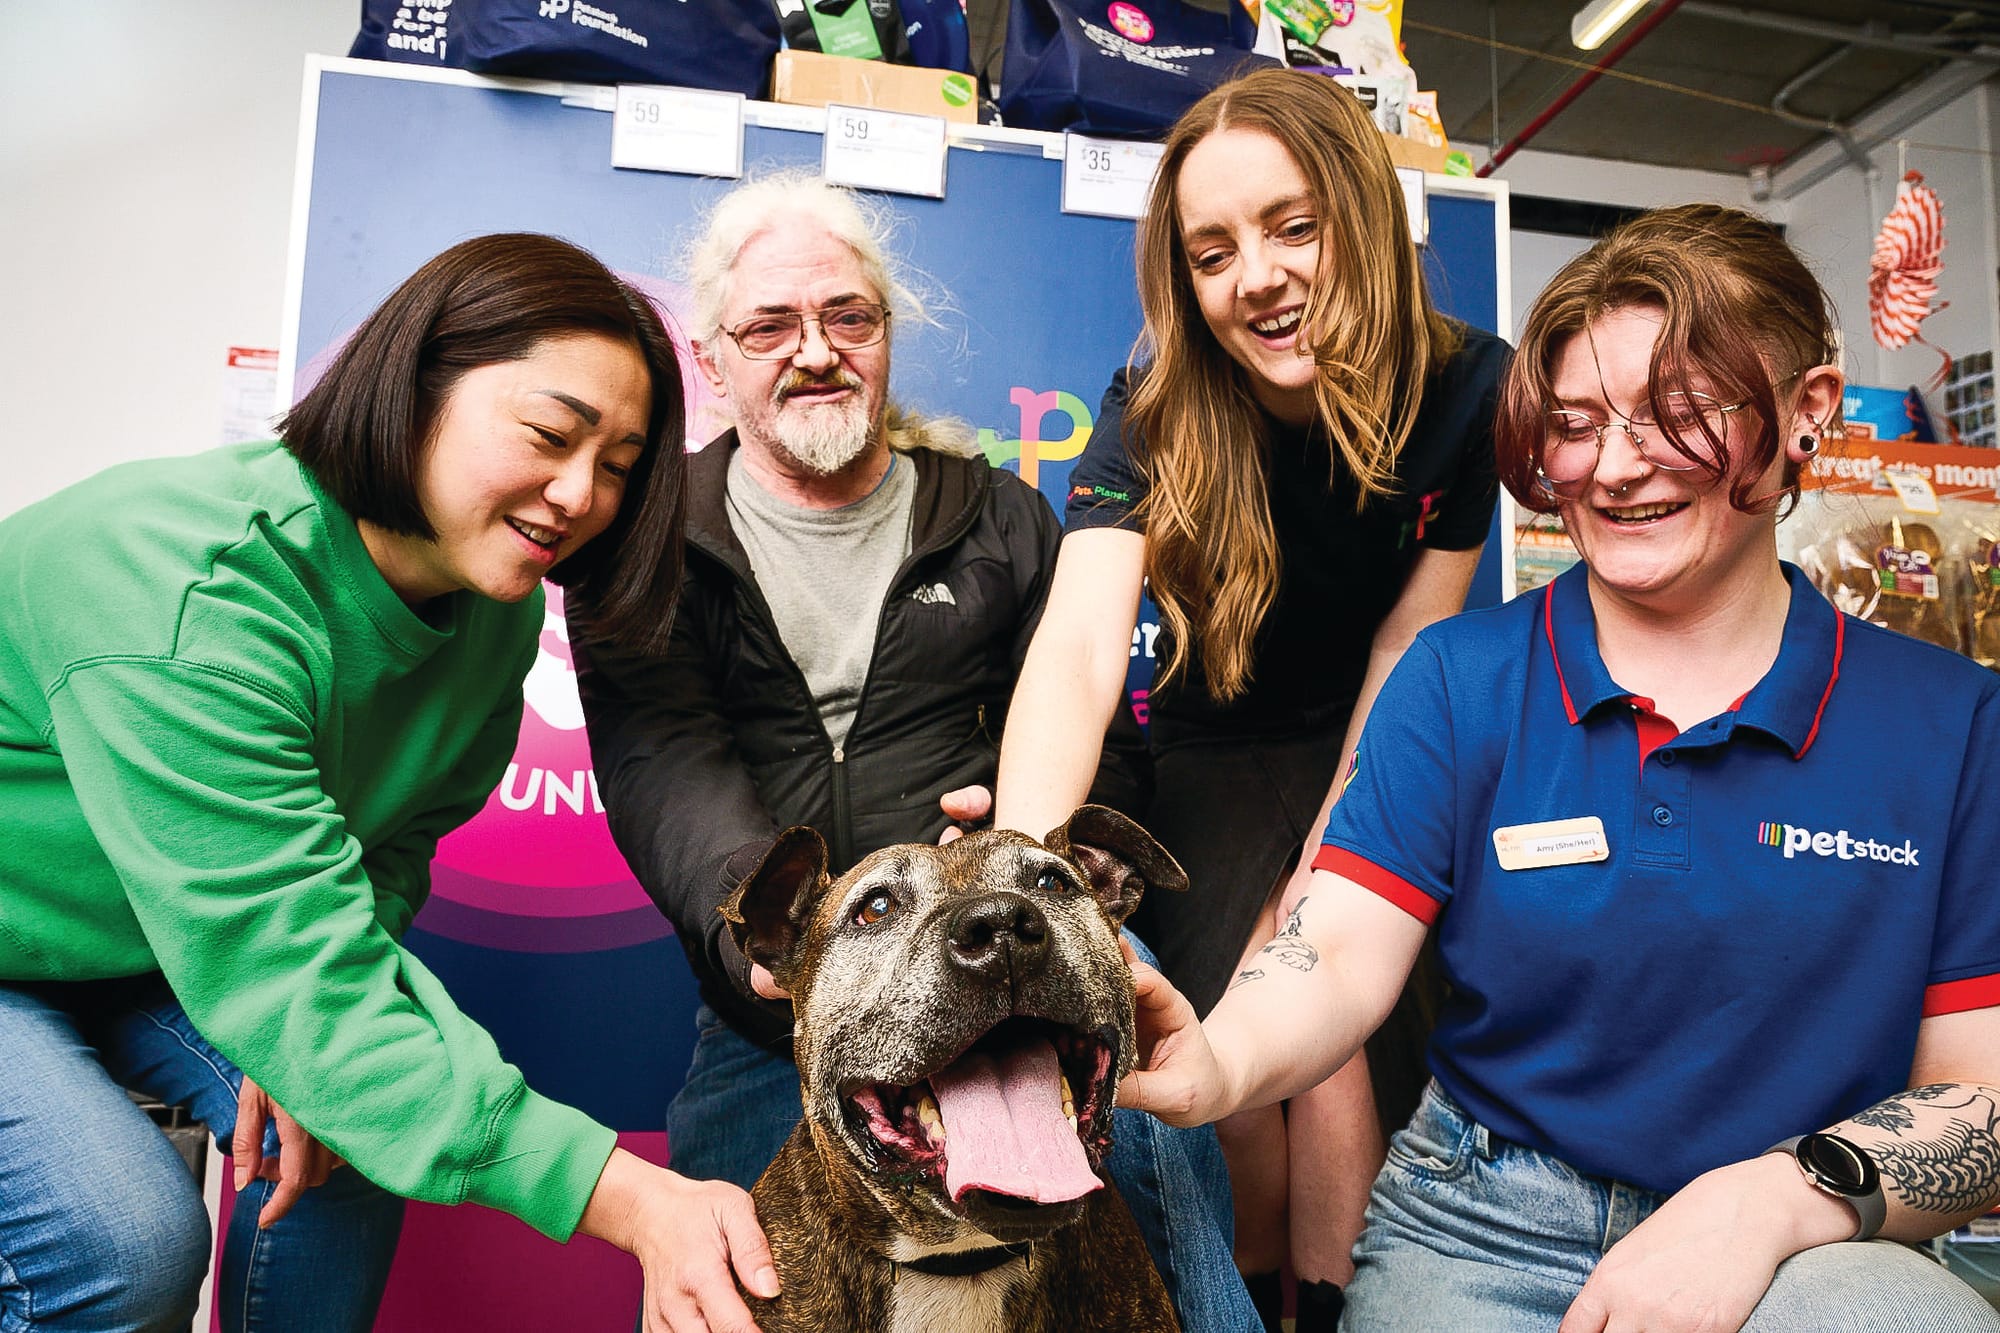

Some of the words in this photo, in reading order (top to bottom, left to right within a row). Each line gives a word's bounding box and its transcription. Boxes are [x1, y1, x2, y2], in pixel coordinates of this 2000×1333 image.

[387, 32, 435, 54] and
[571, 9, 648, 48] Foundation
[1810, 455, 1884, 480] treat
[1782, 823, 1920, 867] petstock
